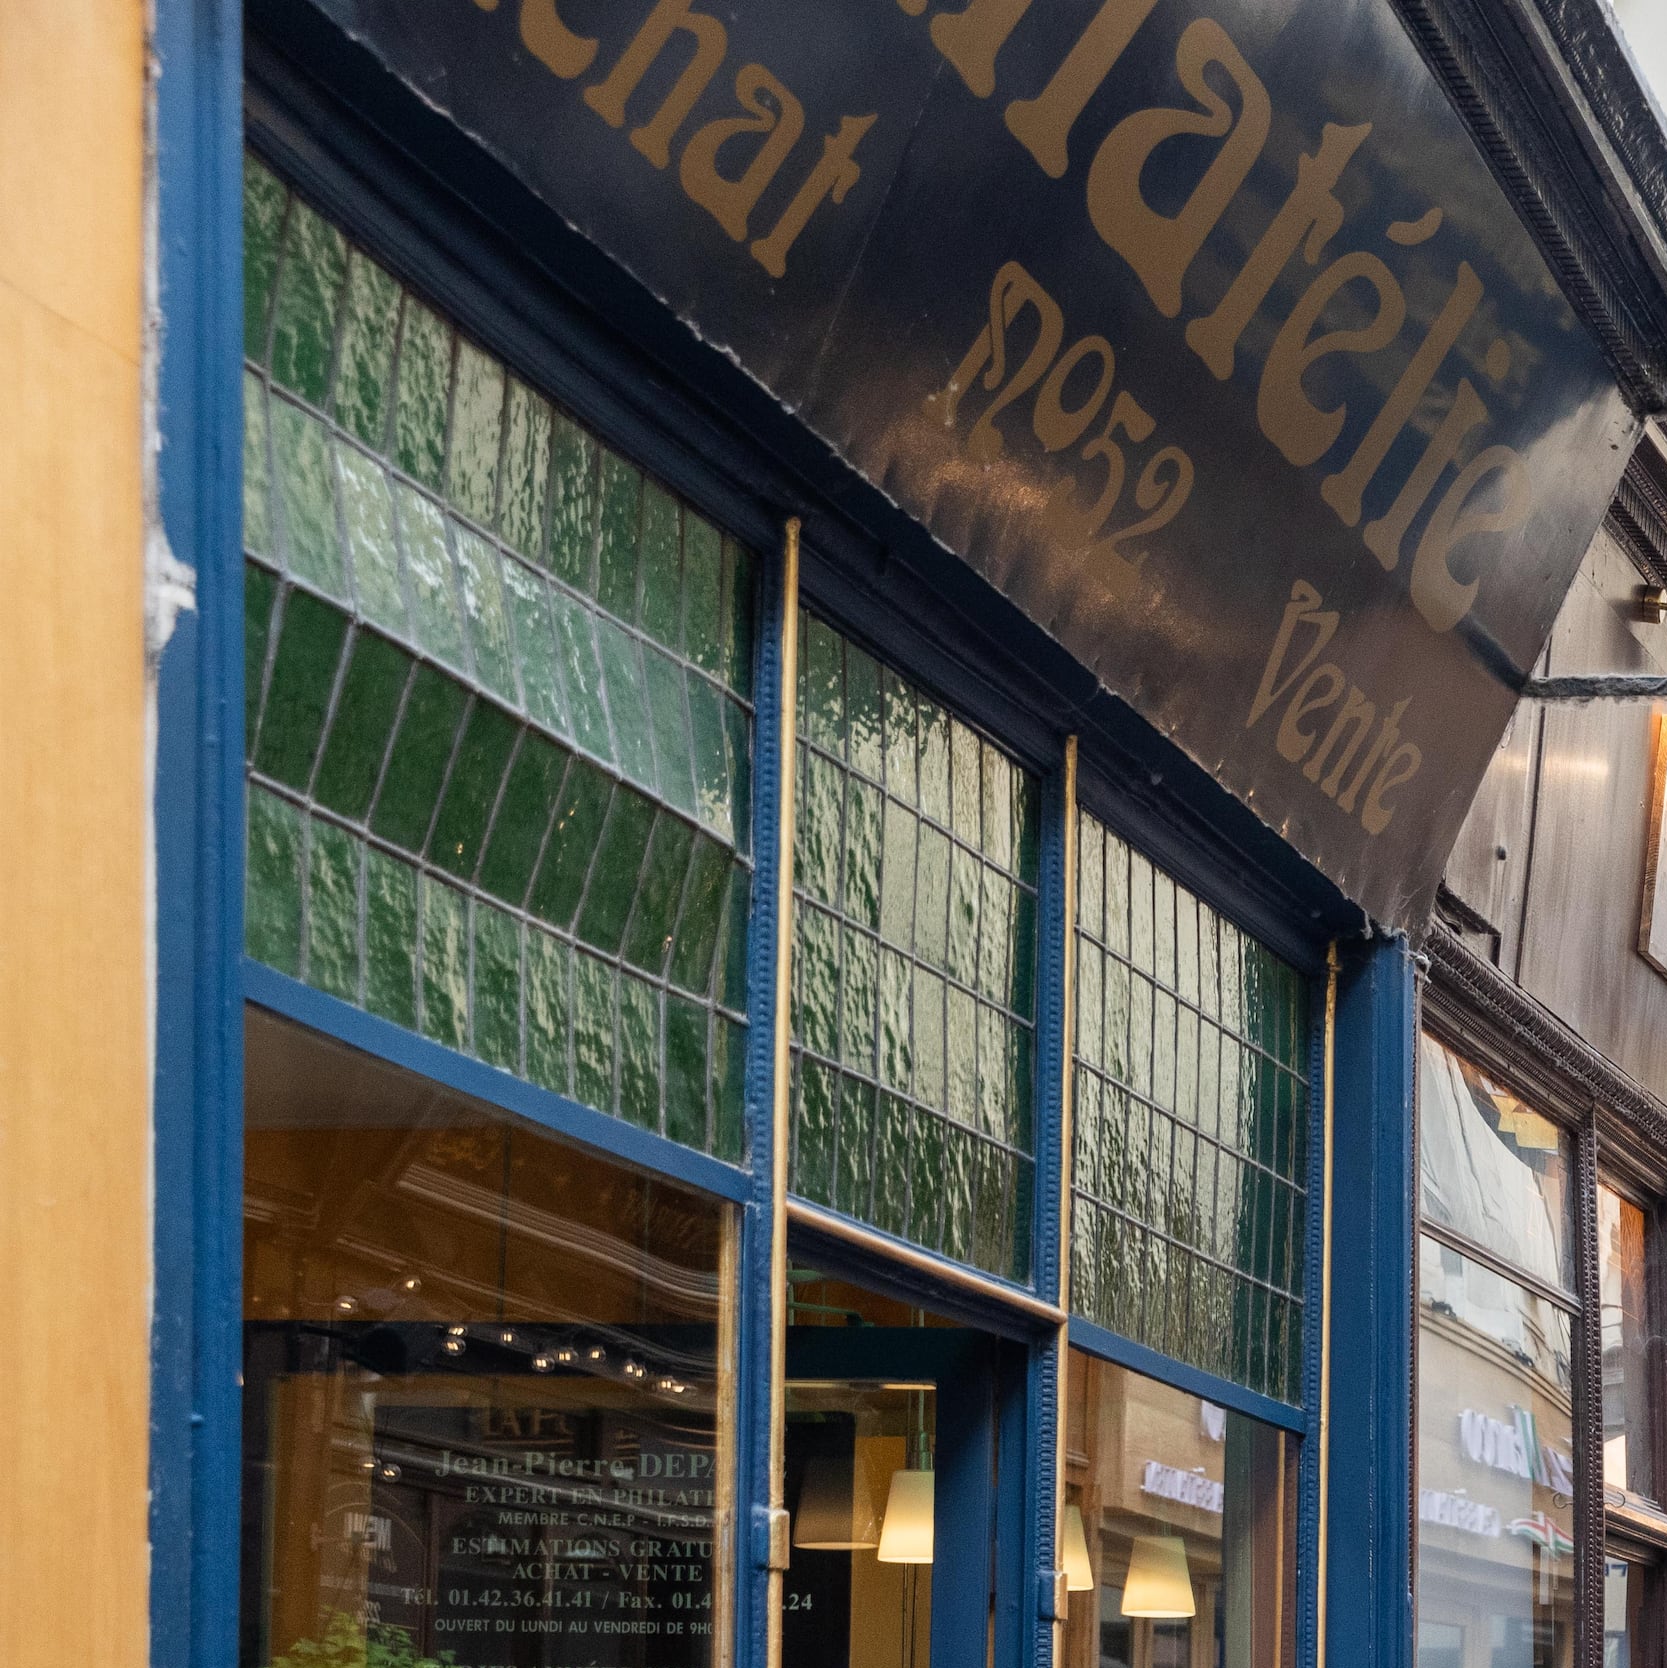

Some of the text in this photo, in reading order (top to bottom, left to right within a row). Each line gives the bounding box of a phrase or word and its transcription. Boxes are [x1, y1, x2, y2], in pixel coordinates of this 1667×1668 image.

[480, 0, 880, 278] chat
[905, 0, 1535, 634] latélie
[1246, 578, 1422, 836] Vente
[466, 1486, 561, 1503] EXPERT
[498, 1511, 569, 1527] MEMBRE
[452, 1536, 621, 1557] ESTIMATIONS
[512, 1561, 703, 1583] ACHAT VENTE
[435, 1618, 490, 1634] OUVERT
[495, 1618, 516, 1634] DU
[521, 1619, 563, 1635] LUNDI
[568, 1619, 589, 1635] AU
[593, 1619, 661, 1636] VENDREDI
[666, 1621, 685, 1636] DE
